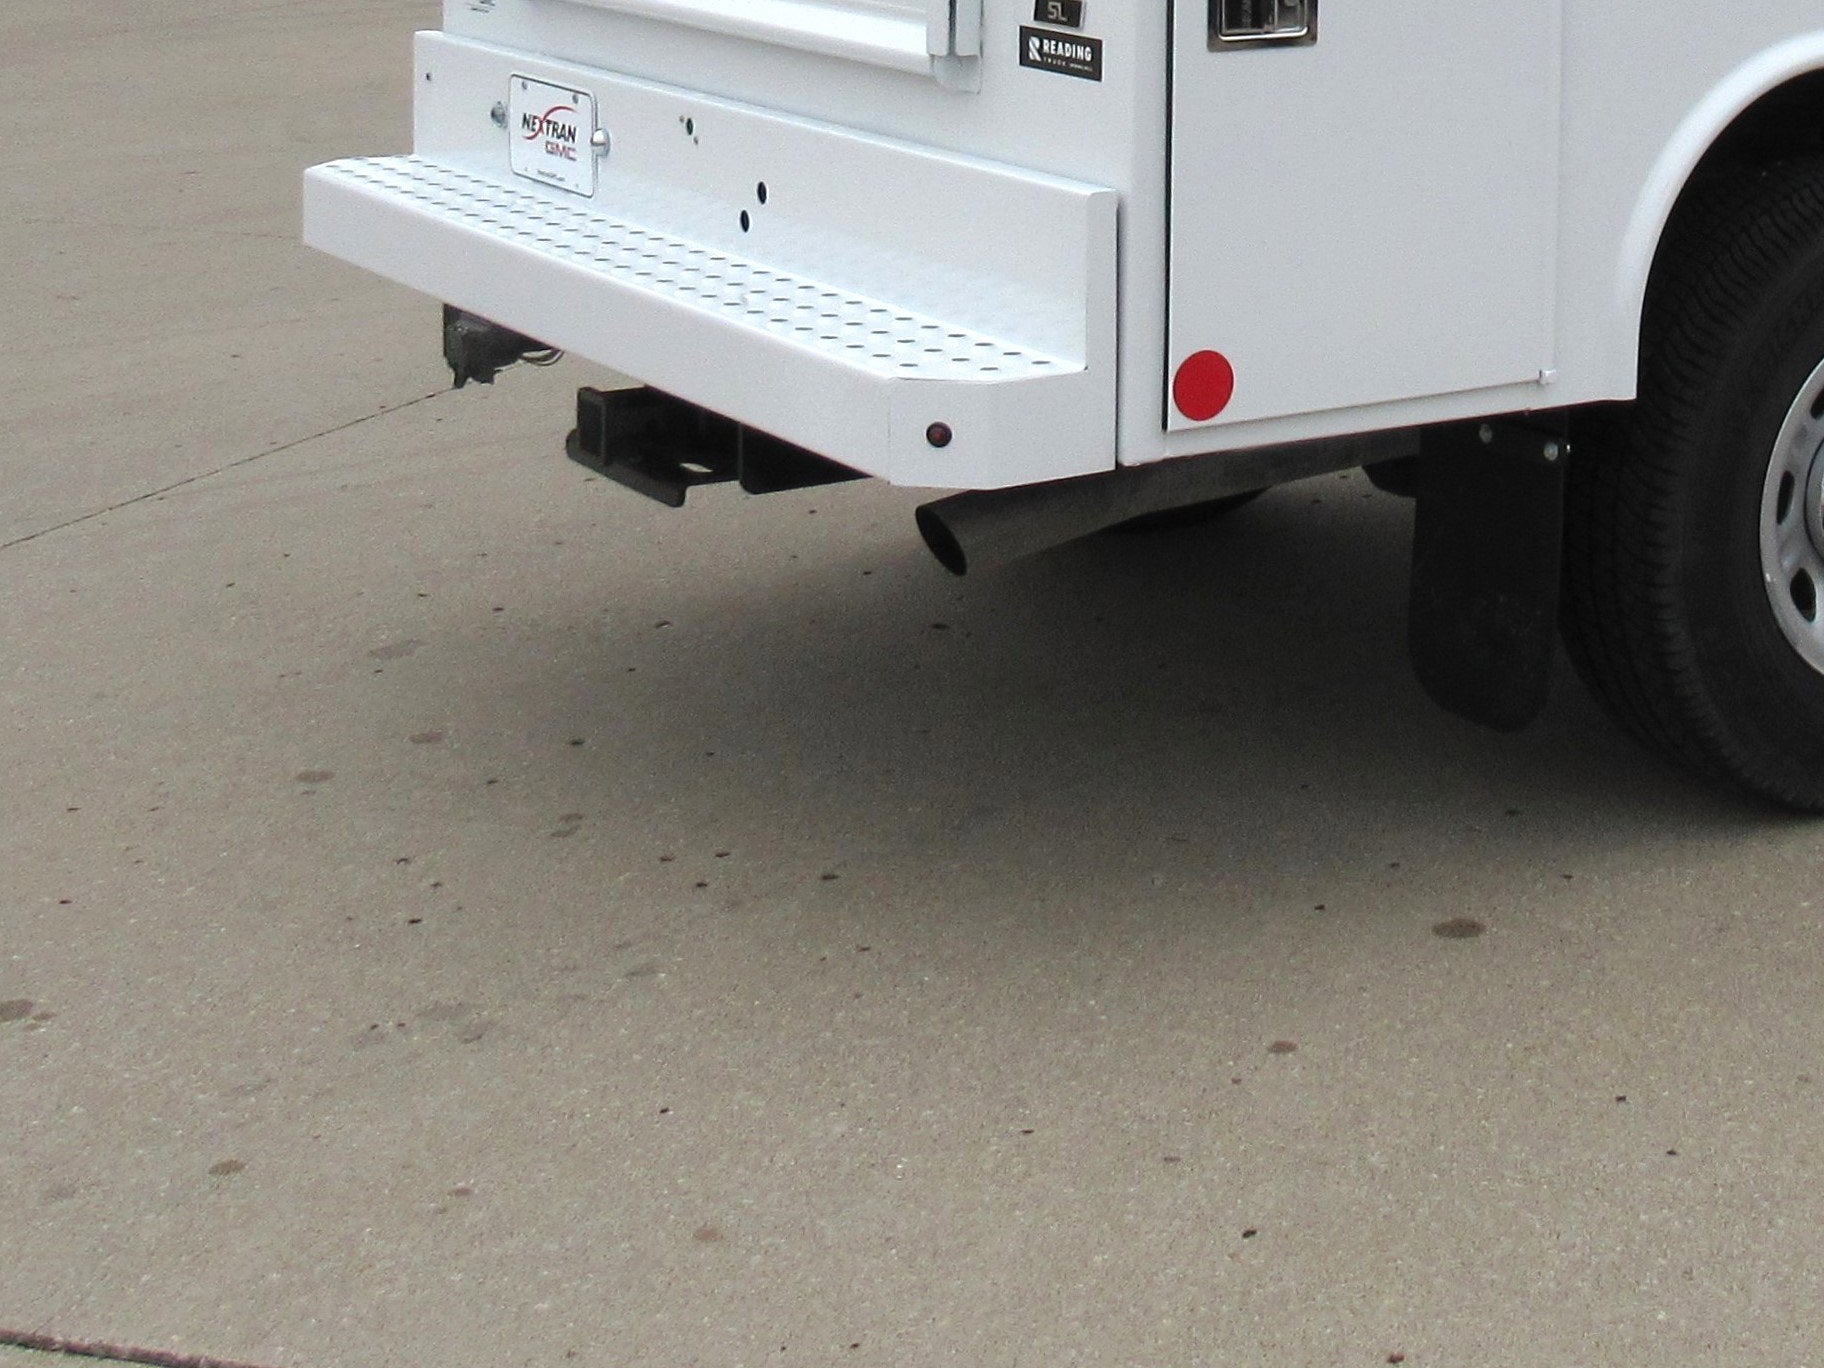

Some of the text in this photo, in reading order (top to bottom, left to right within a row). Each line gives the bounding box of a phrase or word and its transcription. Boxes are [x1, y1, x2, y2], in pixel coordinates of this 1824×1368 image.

[1047, 1, 1068, 22] SL
[1043, 39, 1092, 62] READING
[522, 113, 577, 143] NEXTRAN
[545, 140, 577, 161] GMC
